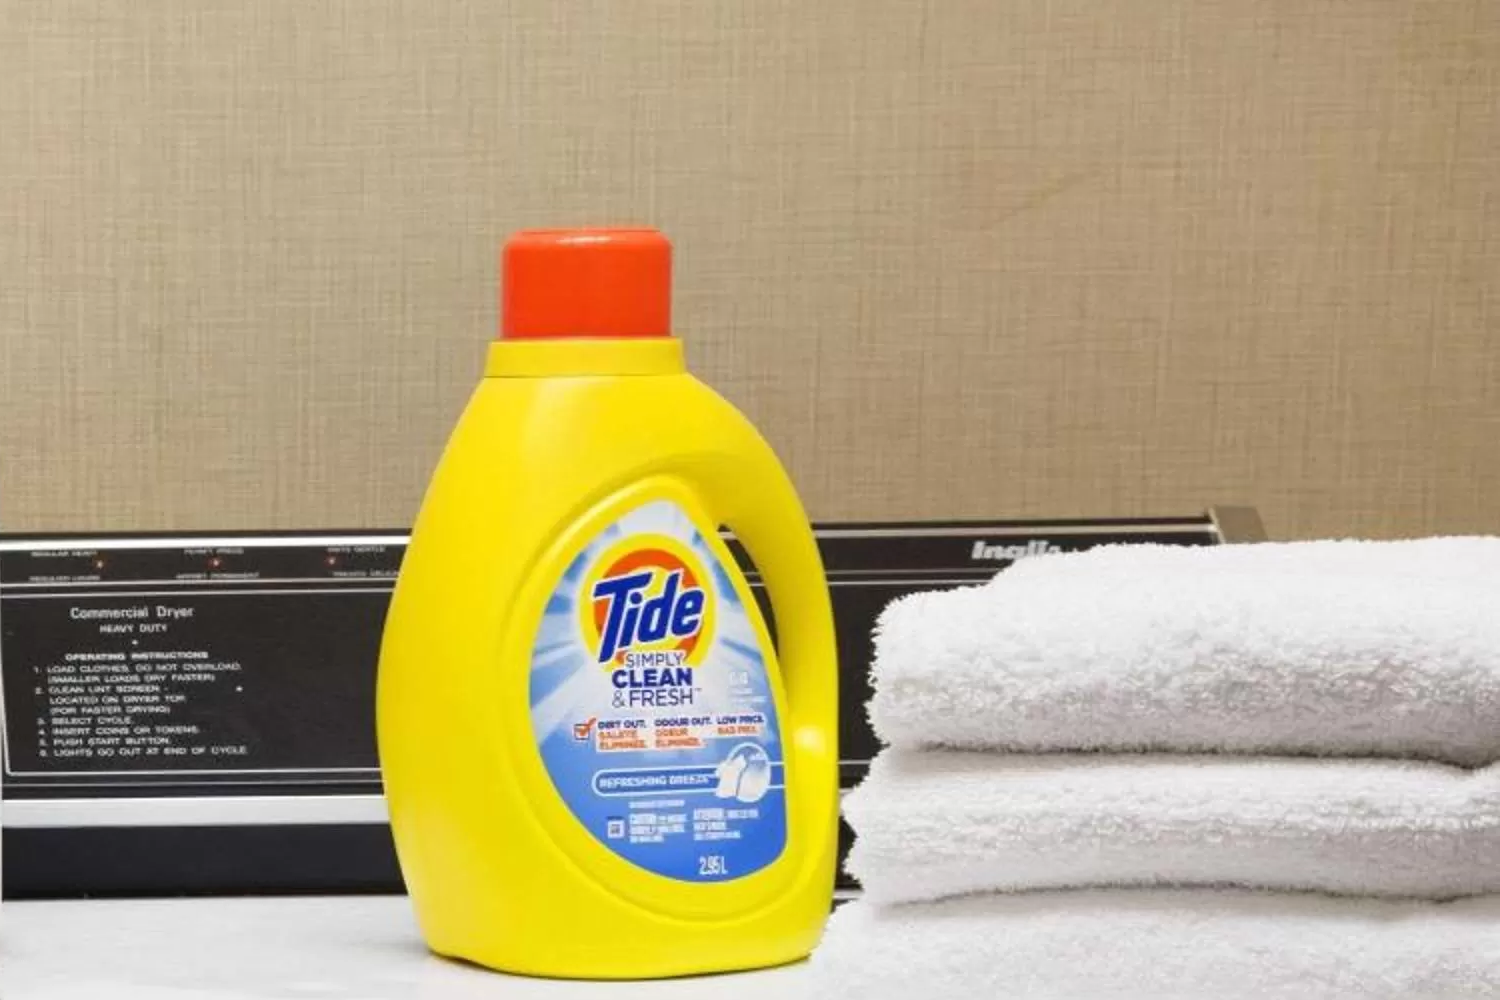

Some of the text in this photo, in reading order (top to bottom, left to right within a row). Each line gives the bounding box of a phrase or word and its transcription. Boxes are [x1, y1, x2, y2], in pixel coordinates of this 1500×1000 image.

[70, 605, 195, 619] Commercial Dryer
[593, 570, 705, 664] Tide
[99, 623, 168, 633] HEAVY DUTY
[65, 651, 209, 661] OPERATING INSTRUCTIONS
[625, 653, 684, 667] SIMPLY
[47, 665, 76, 673] LOAD
[135, 664, 152, 672] DO
[612, 668, 693, 687] CLEAN
[48, 686, 85, 694] CLEAN
[87, 685, 111, 693] LINT
[49, 696, 99, 705] LOCATED
[101, 695, 119, 703] ON
[612, 692, 626, 709] &
[51, 717, 92, 725] SELECT
[598, 721, 621, 729] DIRT
[655, 718, 689, 727] ODOUR
[717, 716, 737, 724] LOW
[133, 726, 151, 734] OR
[52, 738, 83, 747] PUSH
[87, 737, 120, 745] START
[53, 749, 93, 757] LIGHTS
[97, 747, 115, 756] GO
[119, 747, 142, 756] OUT
[145, 747, 160, 755] AT
[163, 747, 187, 755] END
[191, 747, 206, 755] OF
[599, 776, 667, 788] REFRESHING
